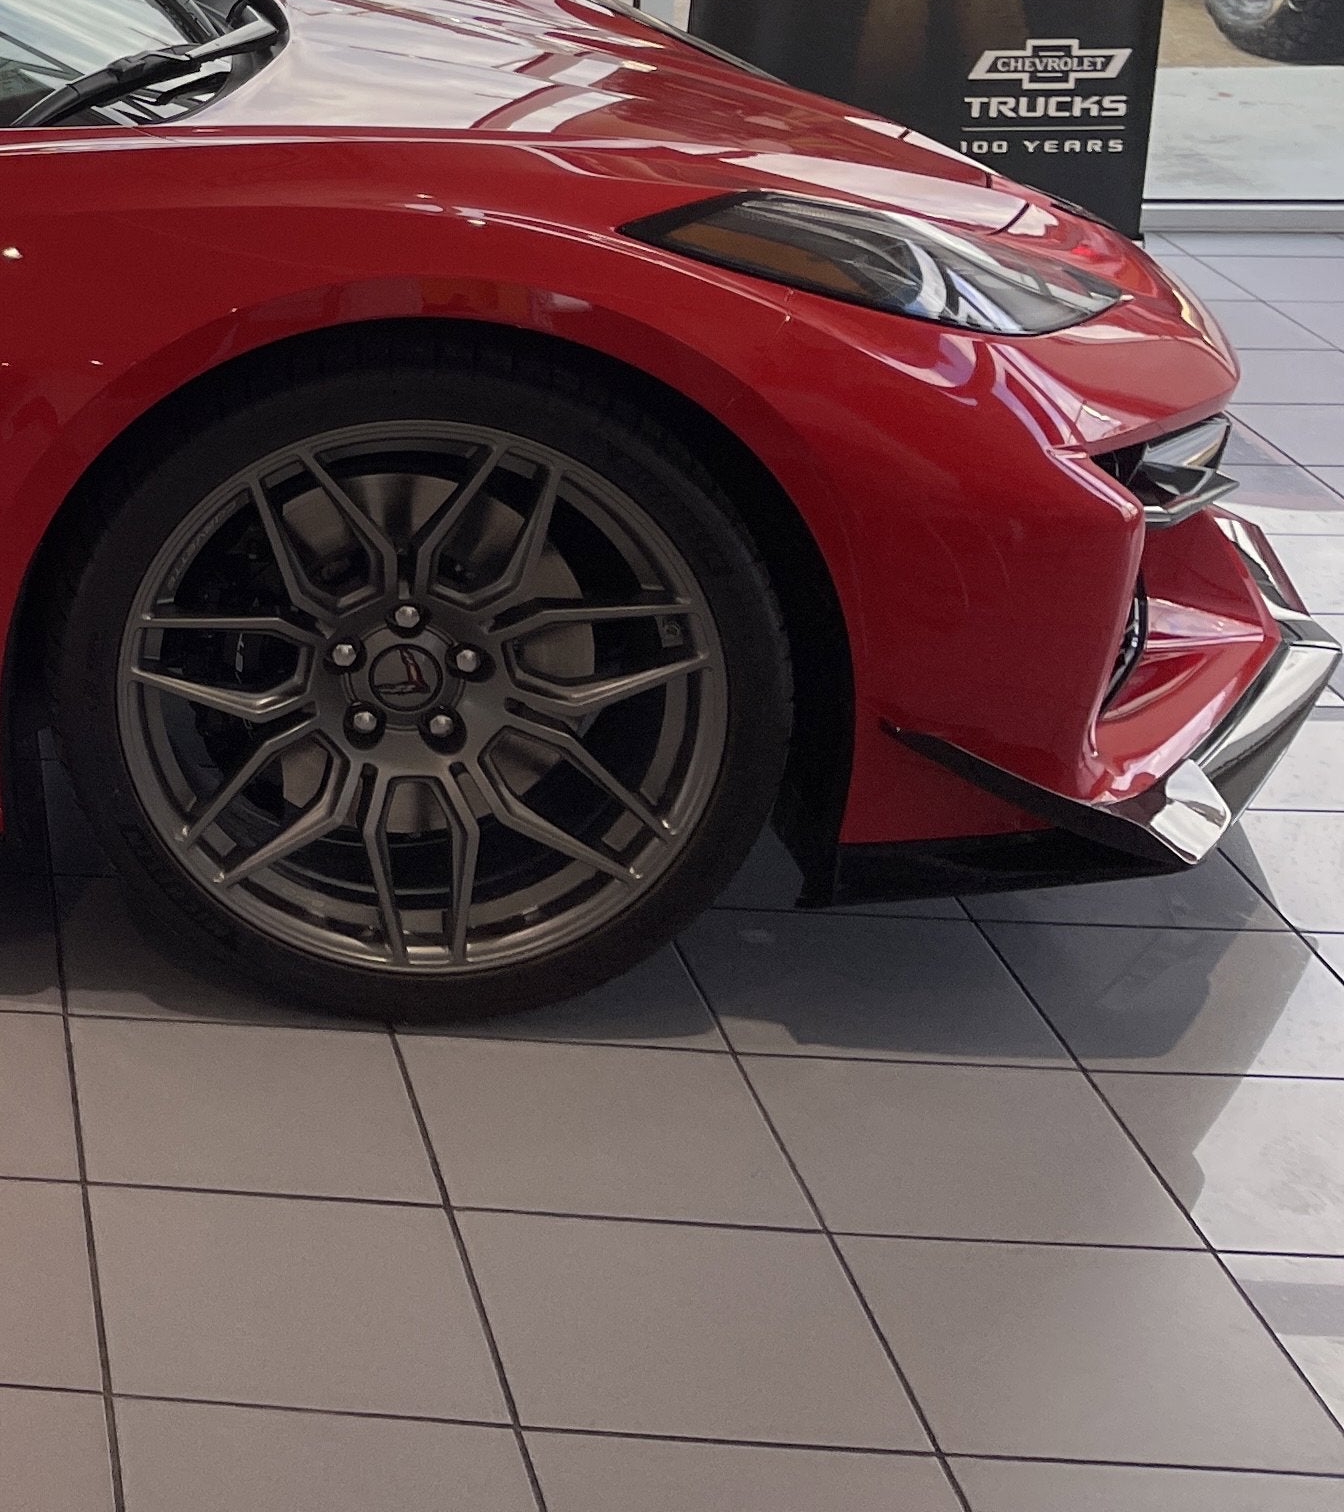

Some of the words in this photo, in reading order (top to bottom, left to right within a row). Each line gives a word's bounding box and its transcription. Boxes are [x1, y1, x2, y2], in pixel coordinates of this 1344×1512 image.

[996, 56, 1106, 72] CHEVROLET
[964, 95, 1128, 119] TRUCKS
[960, 140, 1009, 154] 100
[1023, 139, 1124, 154] YEARS
